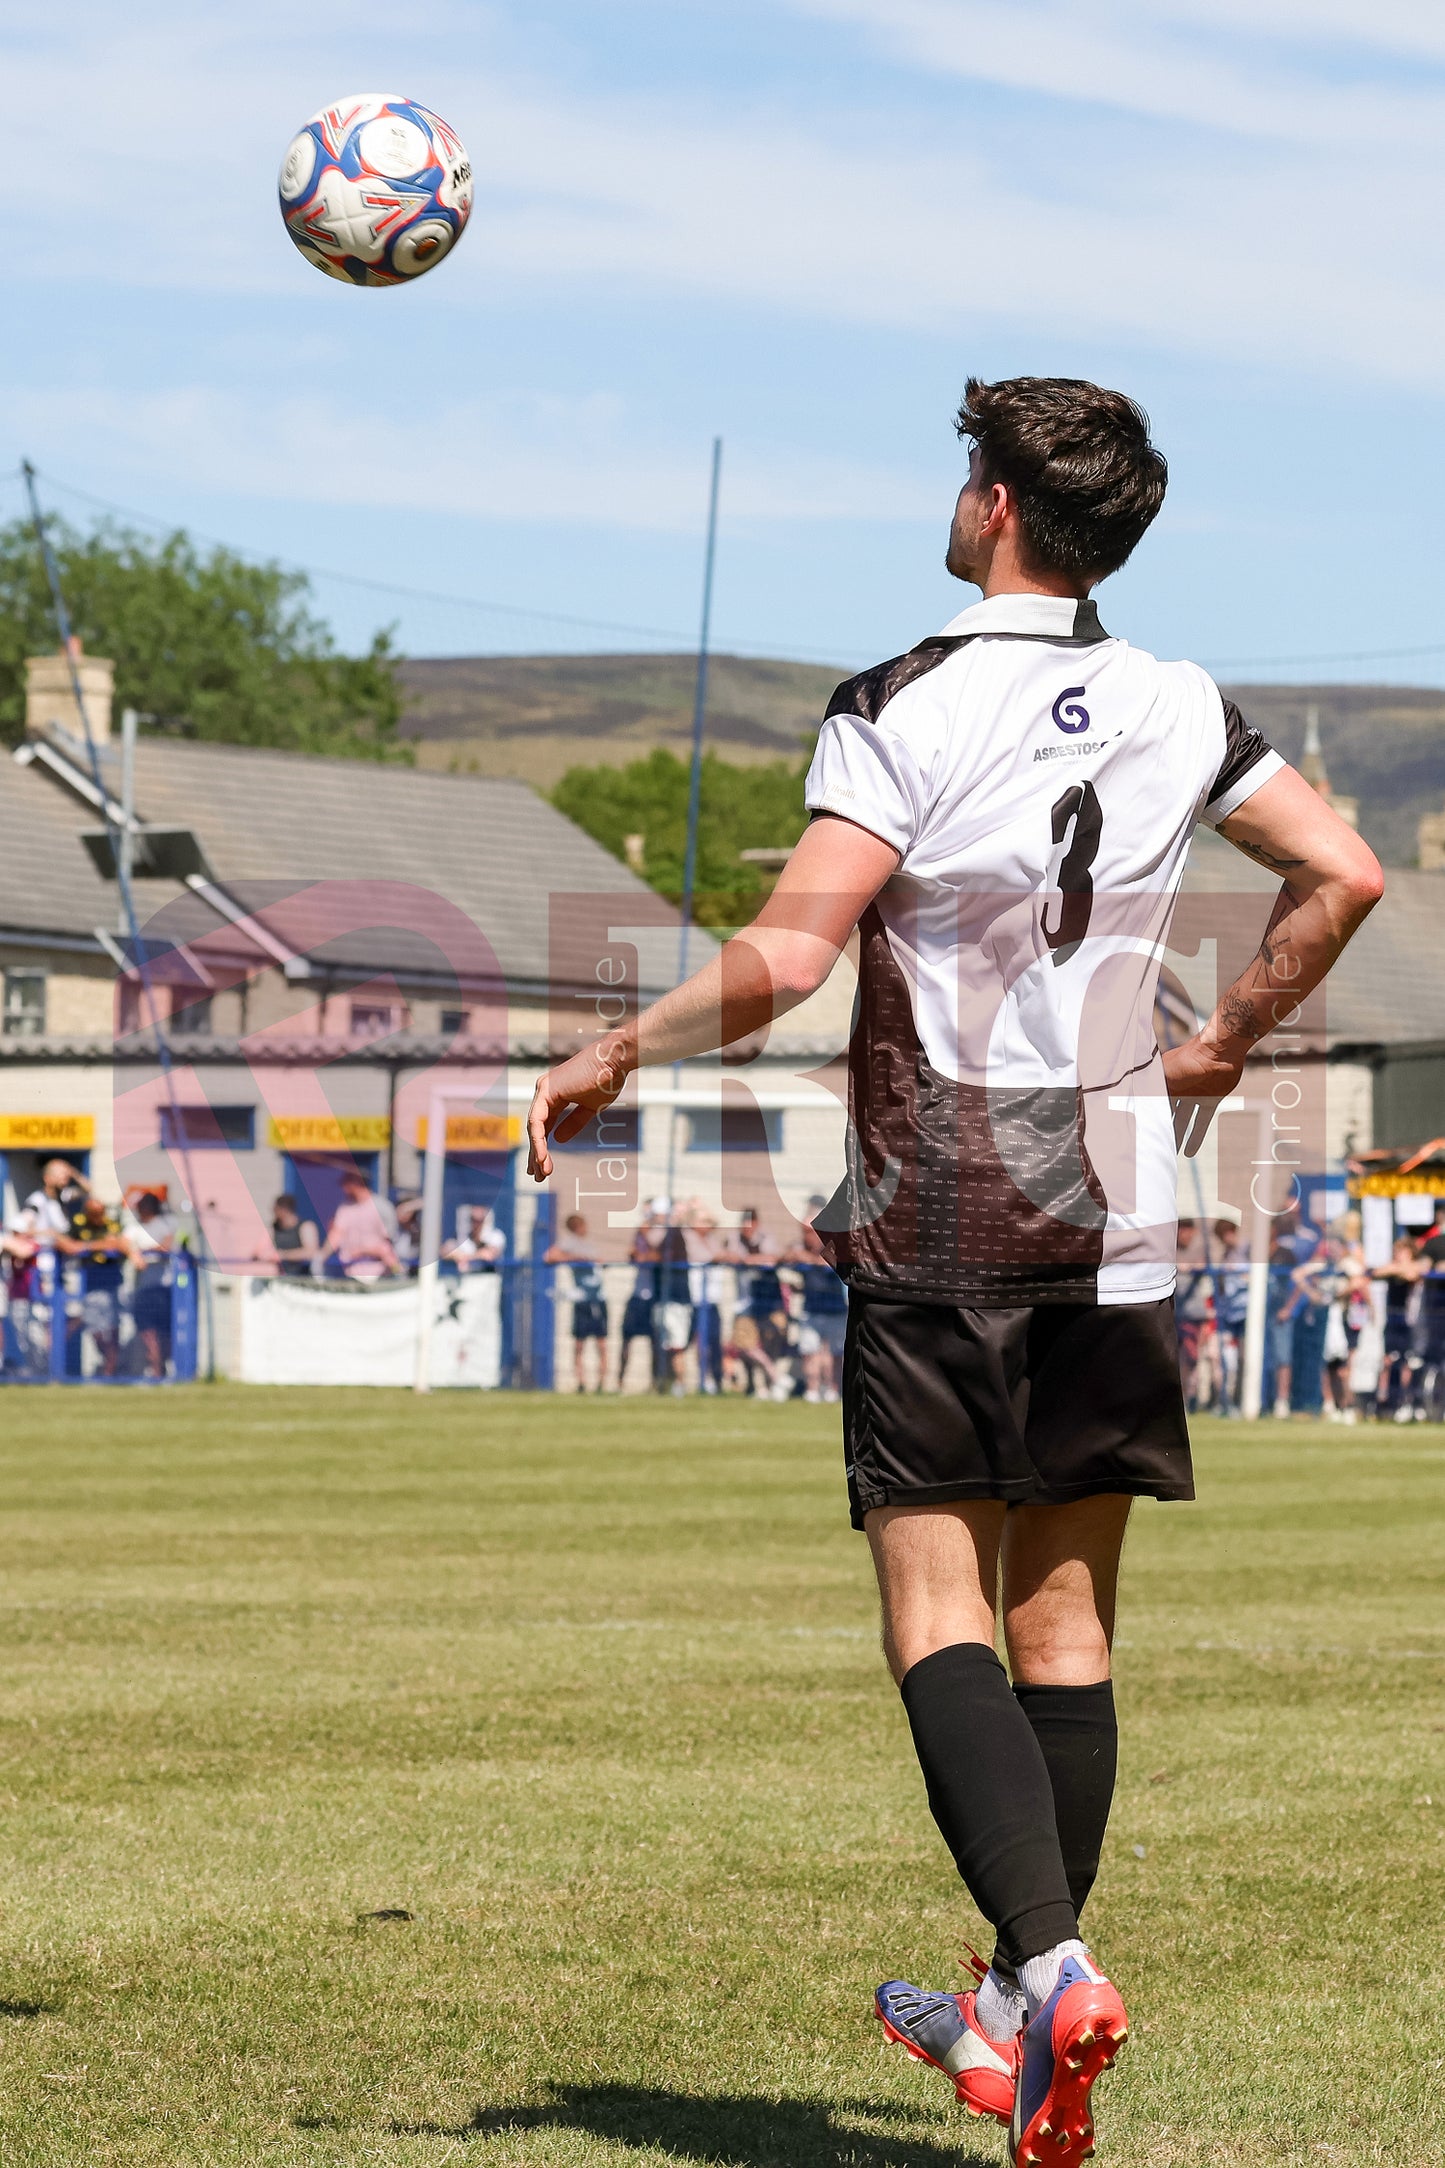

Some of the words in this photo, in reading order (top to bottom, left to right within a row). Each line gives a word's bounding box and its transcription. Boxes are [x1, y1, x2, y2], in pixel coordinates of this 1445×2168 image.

[1033, 742, 1101, 762] ASBESTOS
[1040, 779, 1103, 967] 3
[9, 1118, 77, 1140] HOME
[273, 1118, 391, 1140] OFFICIALS
